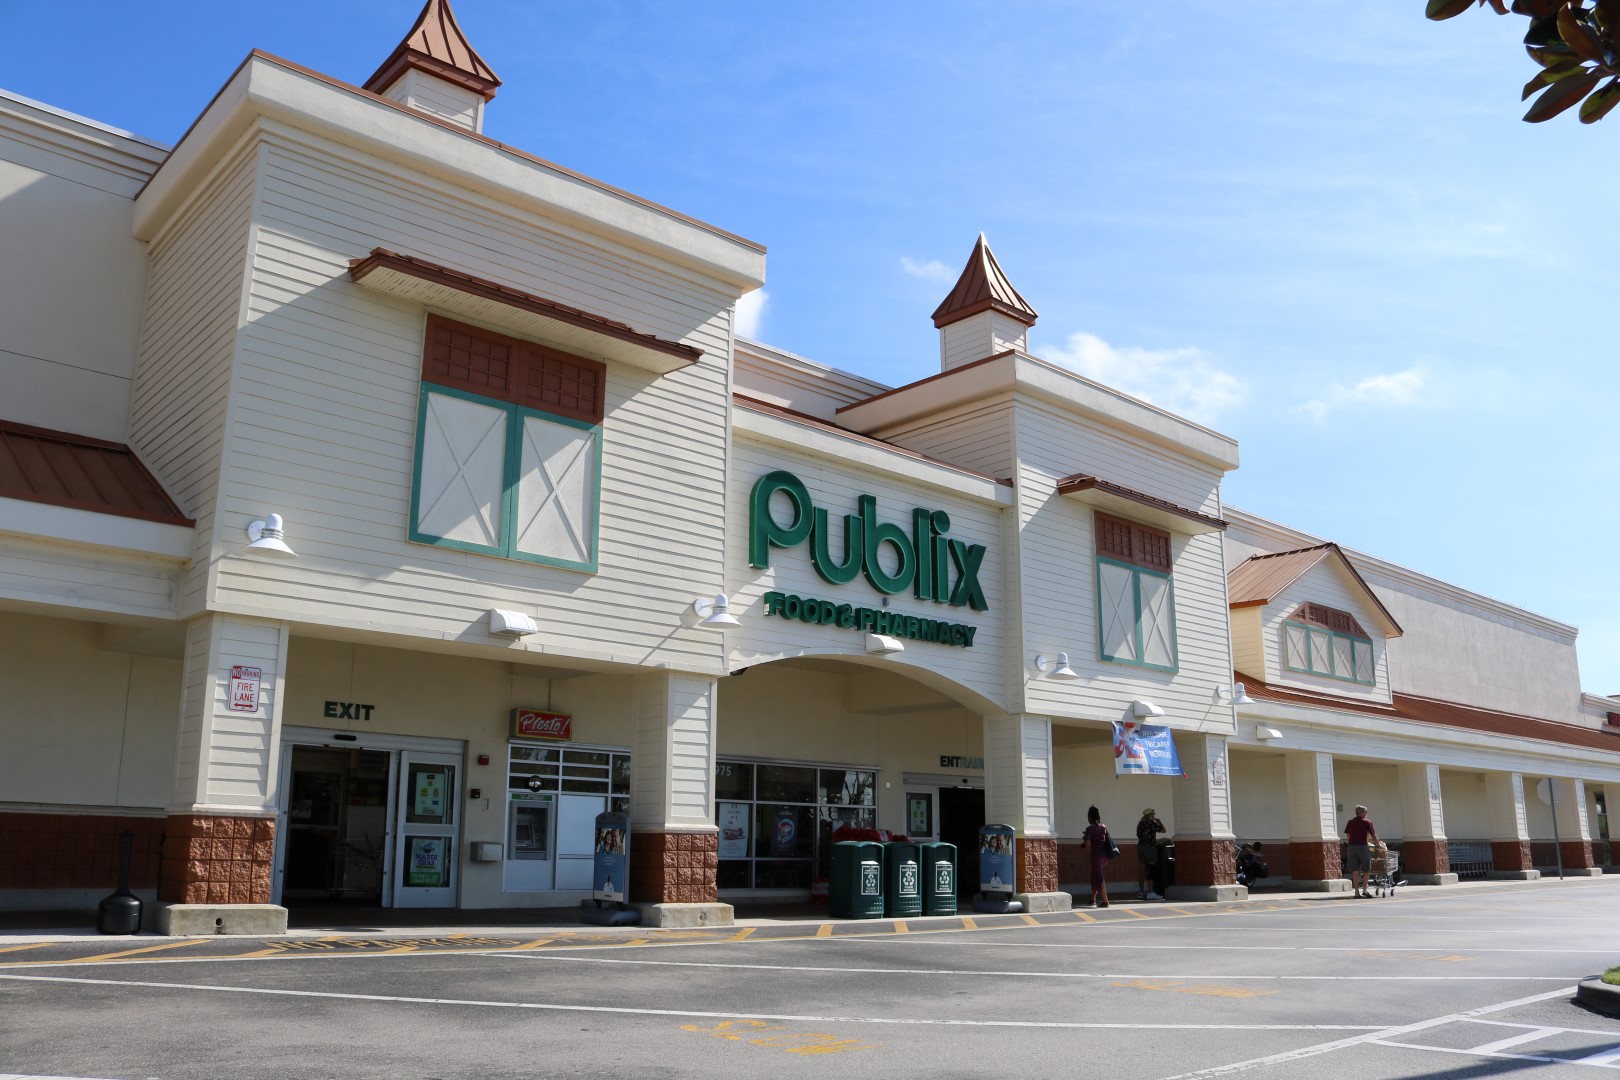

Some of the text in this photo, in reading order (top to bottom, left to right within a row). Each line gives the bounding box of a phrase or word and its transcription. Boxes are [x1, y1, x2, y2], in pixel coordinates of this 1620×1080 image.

[749, 470, 989, 612] Publix
[764, 591, 977, 647] FOOD & PHARMACY
[232, 669, 241, 678] NO
[237, 682, 254, 692] FIRE
[234, 693, 255, 702] LANE
[324, 701, 375, 721] EXIT
[520, 713, 570, 735] Presto!
